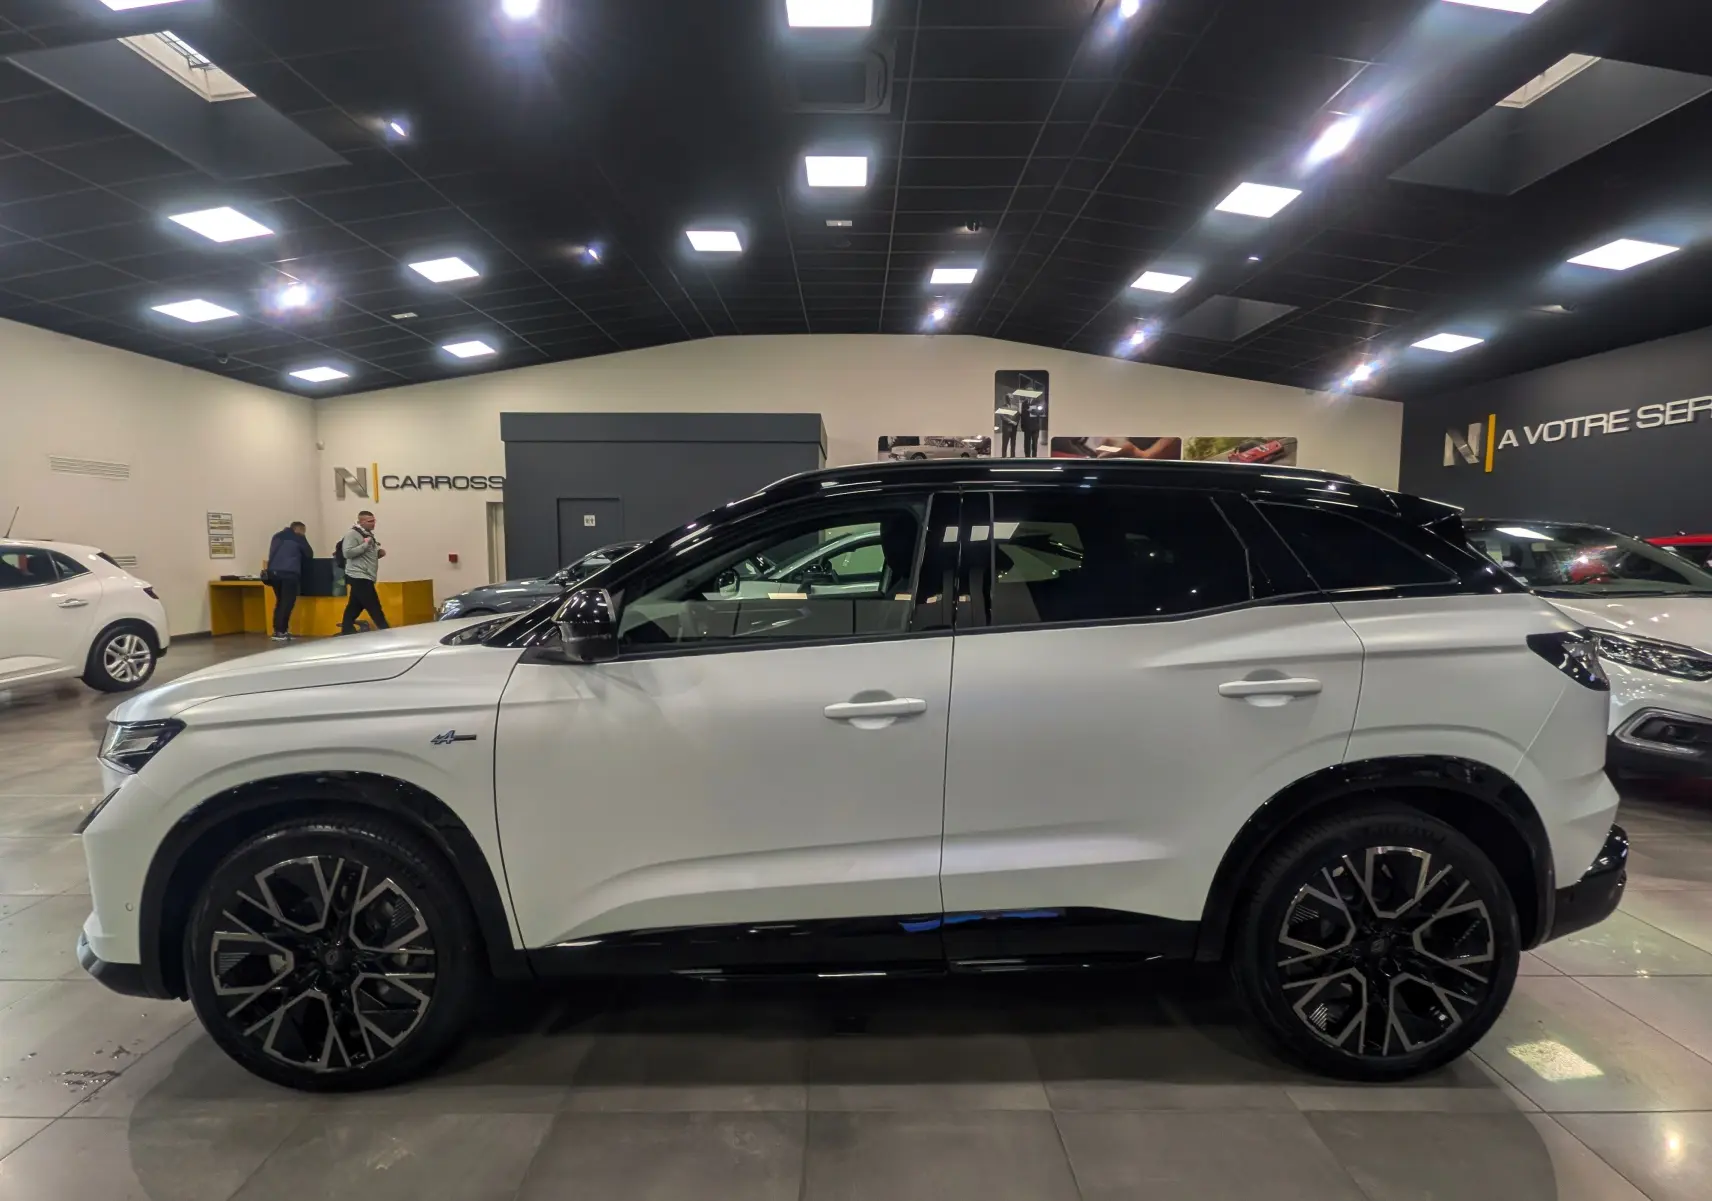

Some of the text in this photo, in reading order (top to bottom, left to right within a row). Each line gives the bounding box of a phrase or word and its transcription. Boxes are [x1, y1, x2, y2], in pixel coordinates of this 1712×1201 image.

[1498, 429, 1519, 449] A
[1523, 408, 1631, 445] VOTRE
[1636, 395, 1712, 429] SER
[334, 467, 506, 500] N CARROSS
